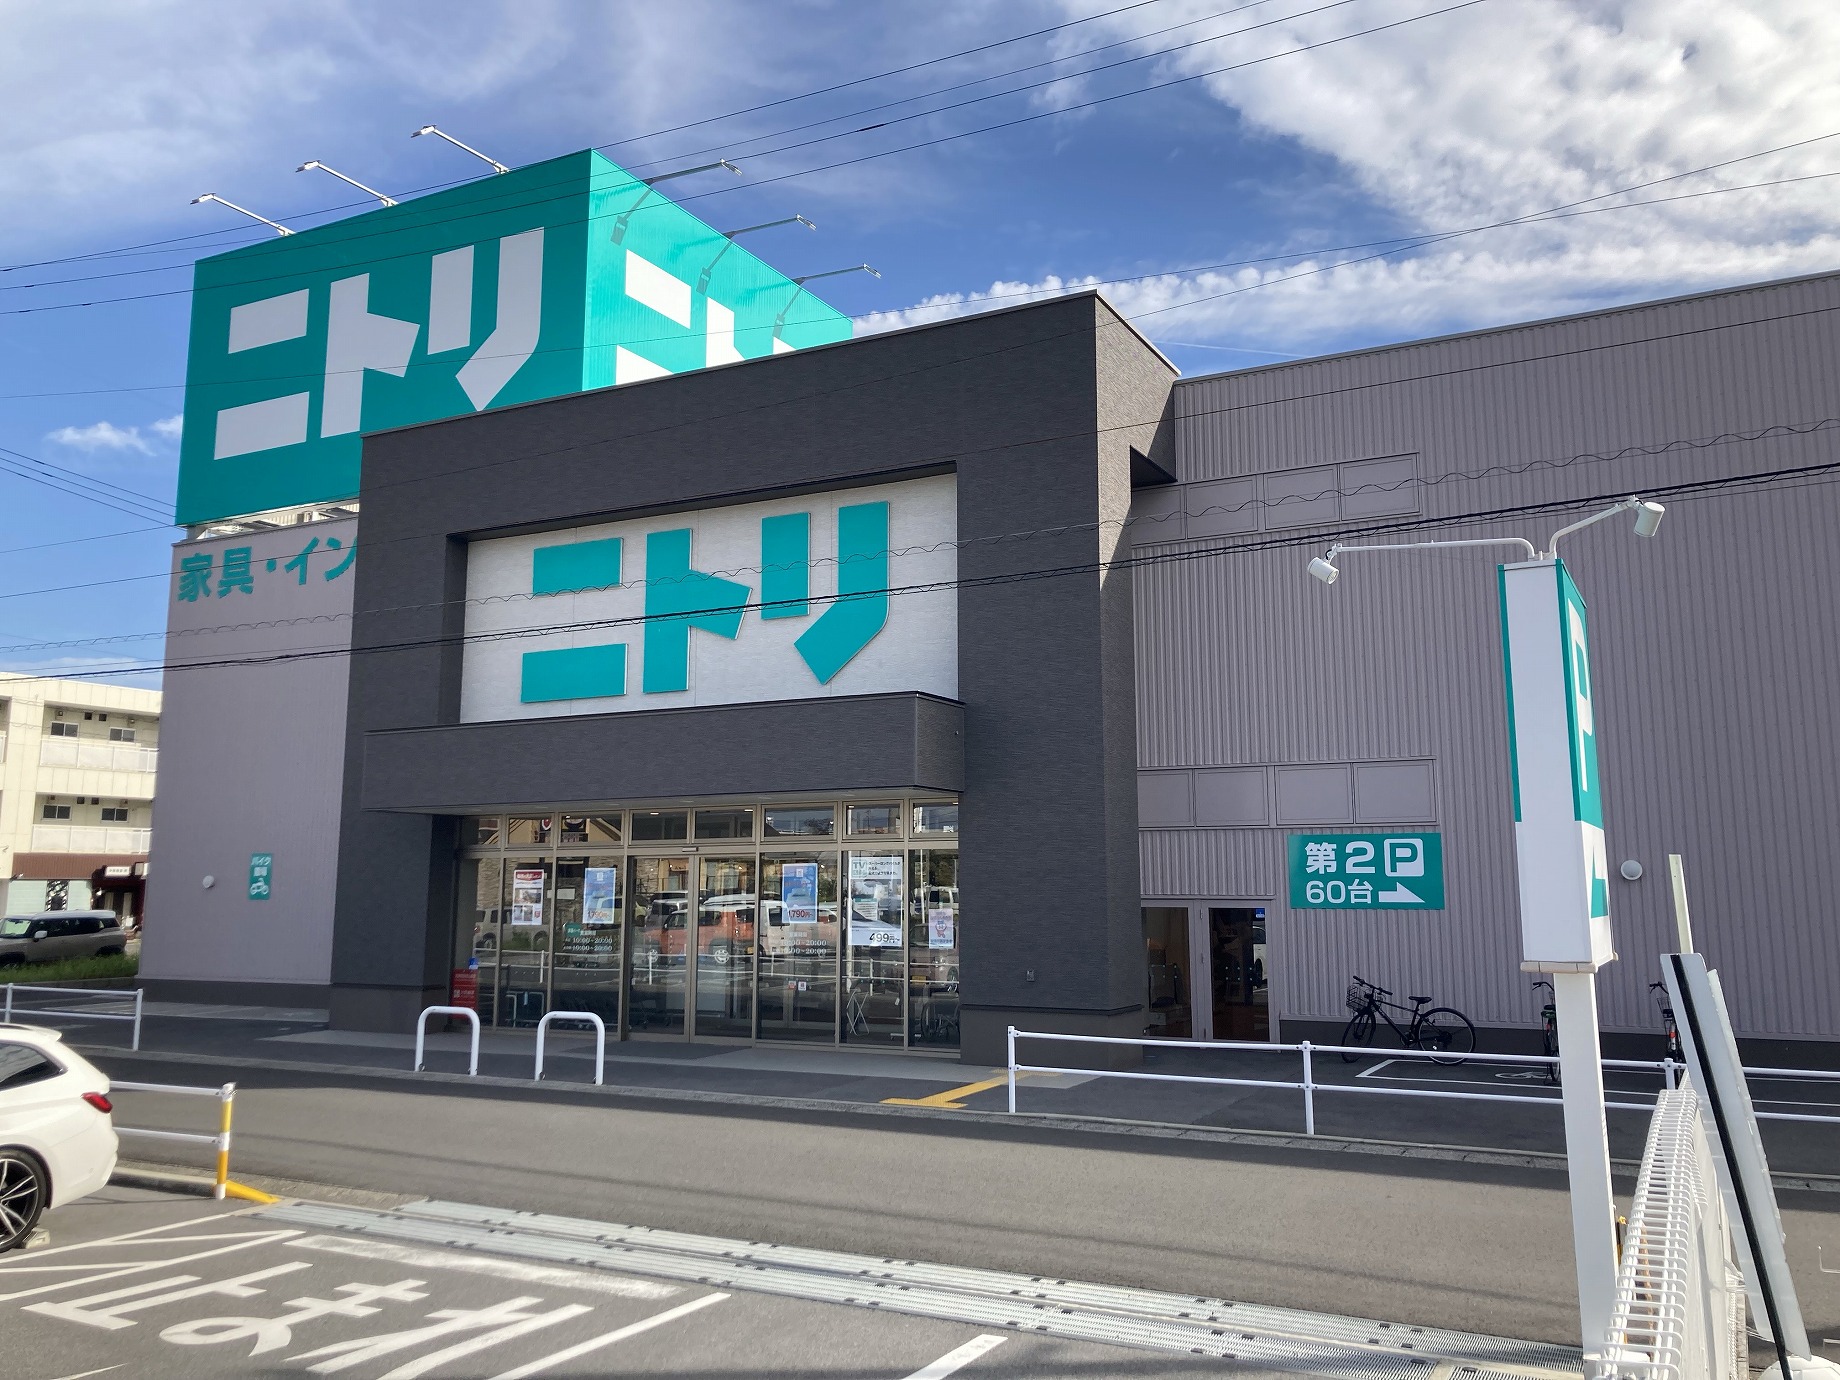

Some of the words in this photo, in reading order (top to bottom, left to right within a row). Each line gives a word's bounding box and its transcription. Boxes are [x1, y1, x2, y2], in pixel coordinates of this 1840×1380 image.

[214, 226, 544, 461] ニトリ
[177, 536, 358, 603] 家具・イン
[520, 501, 891, 703] ニトリ
[853, 861, 866, 869] TV
[1306, 878, 1374, 904] 60台
[21, 1260, 595, 1380] 止まれ
